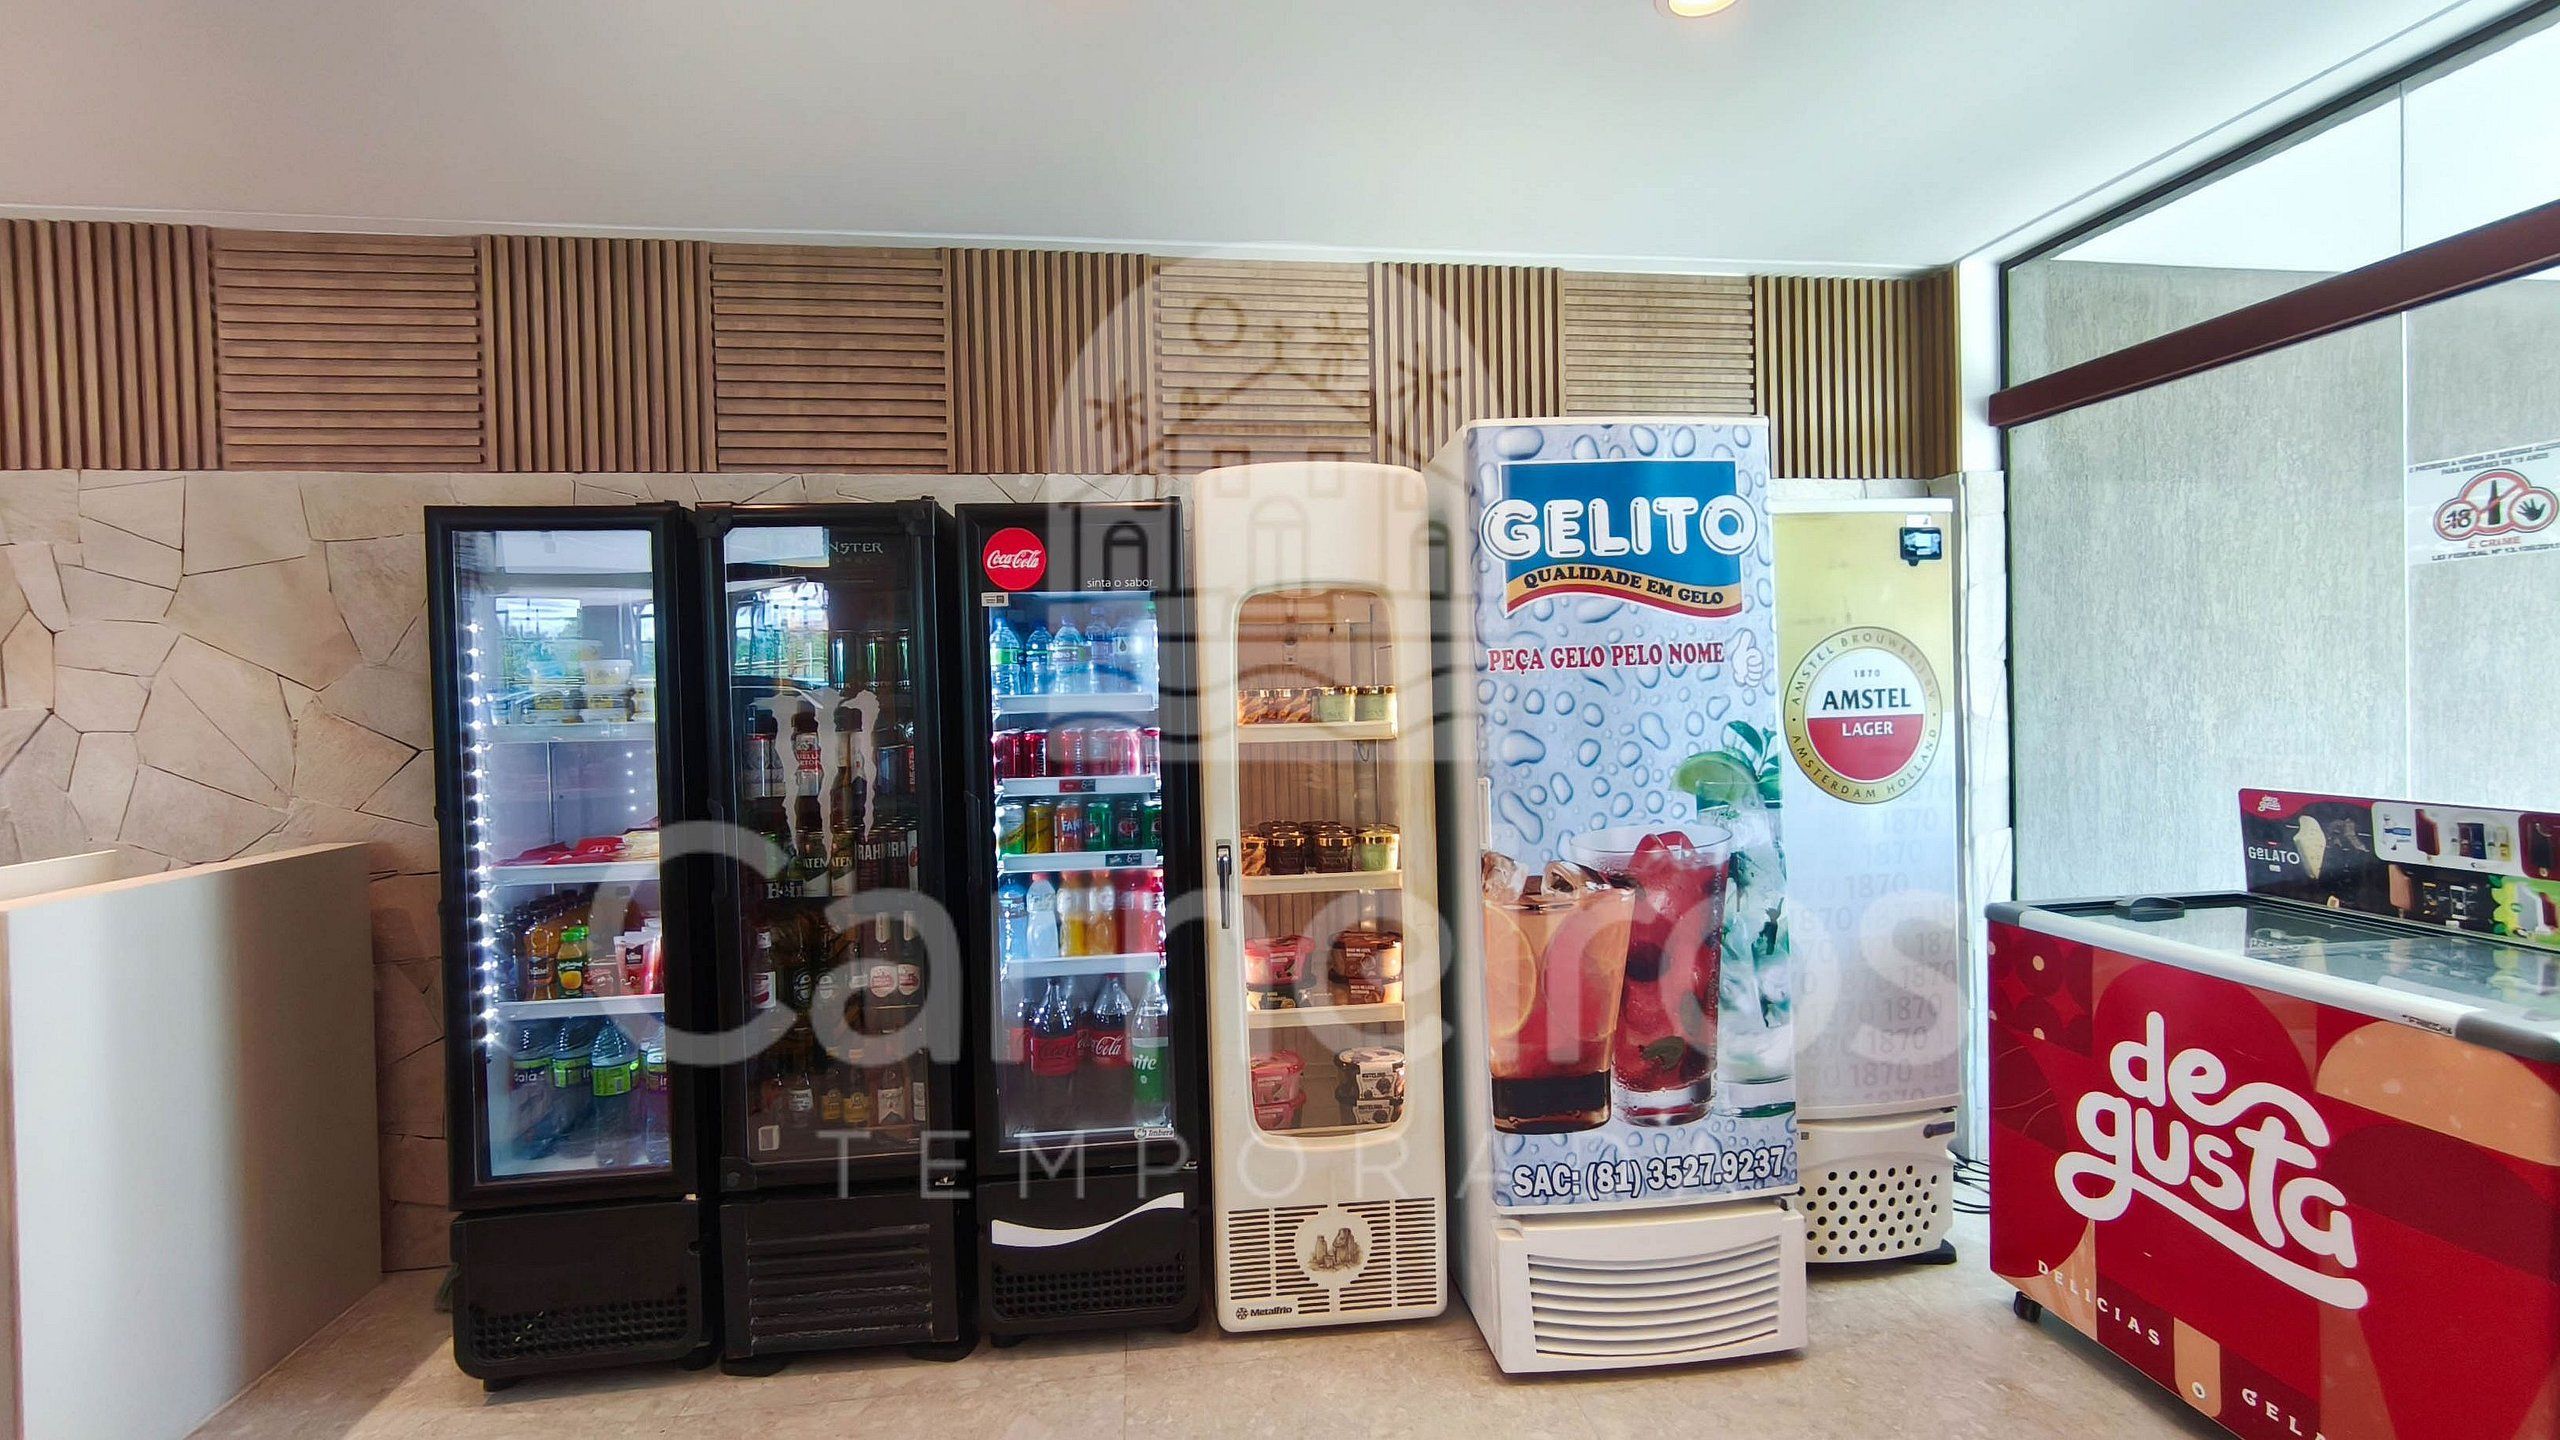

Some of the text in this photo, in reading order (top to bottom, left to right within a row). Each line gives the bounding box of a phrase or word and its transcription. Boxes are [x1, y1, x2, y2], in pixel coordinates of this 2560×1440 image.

[1479, 494, 1758, 560] GELITO
[987, 549, 1042, 569] Coca-Cola
[1087, 577, 1112, 588] sinta
[1114, 580, 1122, 588] o
[1524, 566, 1724, 606] QUALIDADE EM GELO
[1488, 642, 1725, 675] PEÇA GELO PELO NOME
[1854, 668, 1881, 679] 1870
[1791, 647, 1835, 706] AMSTEL
[1821, 687, 1912, 711] AMSTEL
[1842, 721, 1894, 737] LAGER
[1792, 729, 1938, 799] AMSTERDAM HOLLAND
[1512, 1144, 1787, 1201] SAC: (81) 3527.9237
[2054, 1090, 2369, 1310] gusta
[1250, 1306, 1293, 1318] Metalfrio
